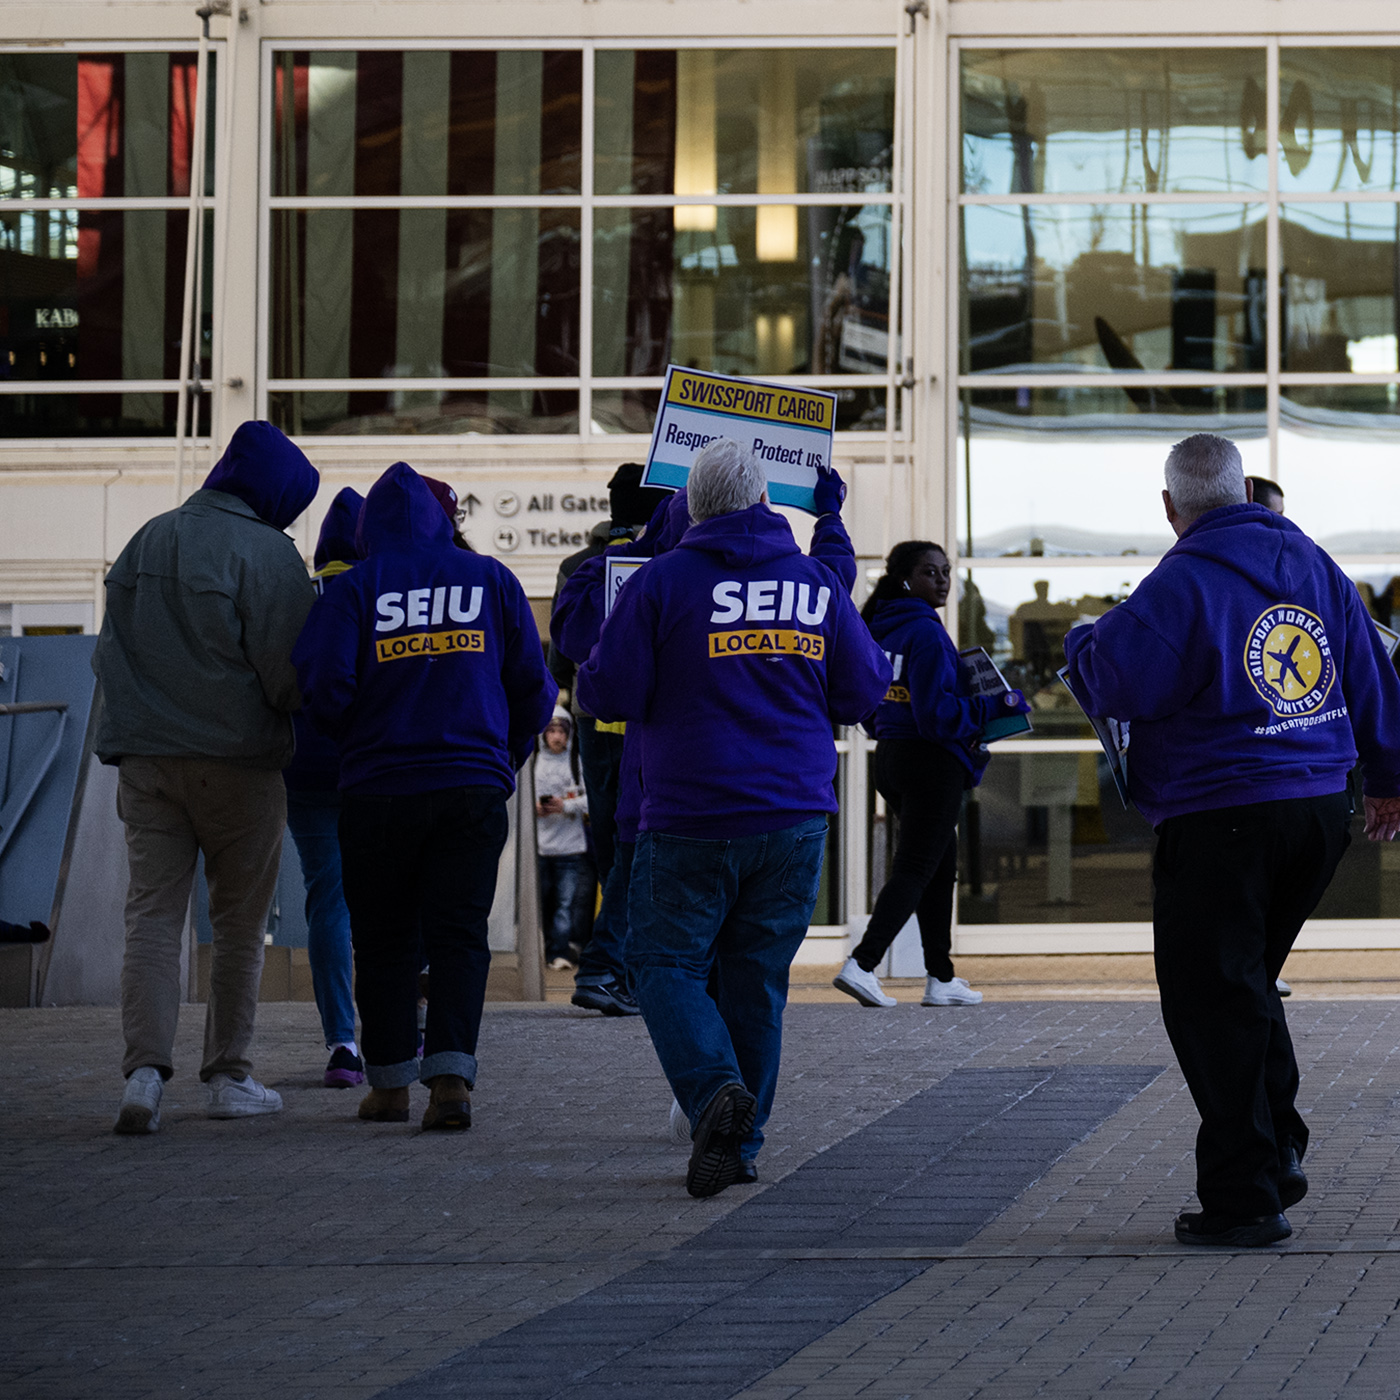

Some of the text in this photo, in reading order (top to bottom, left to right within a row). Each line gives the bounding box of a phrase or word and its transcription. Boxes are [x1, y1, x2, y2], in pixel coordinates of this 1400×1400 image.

[35, 308, 80, 328] KAB
[679, 378, 825, 423] SWISSPORT CARGO
[665, 423, 724, 451] Respe
[752, 438, 804, 466] Protect
[528, 495, 610, 512] All Gate
[528, 529, 592, 547] Ticket
[375, 586, 484, 632] SEIU
[710, 580, 831, 626] SEIU
[380, 633, 481, 658] LOCAL 105
[714, 633, 822, 656] LOCAL 105
[1249, 614, 1276, 677] AIRPORT
[1276, 689, 1323, 714] UNITED
